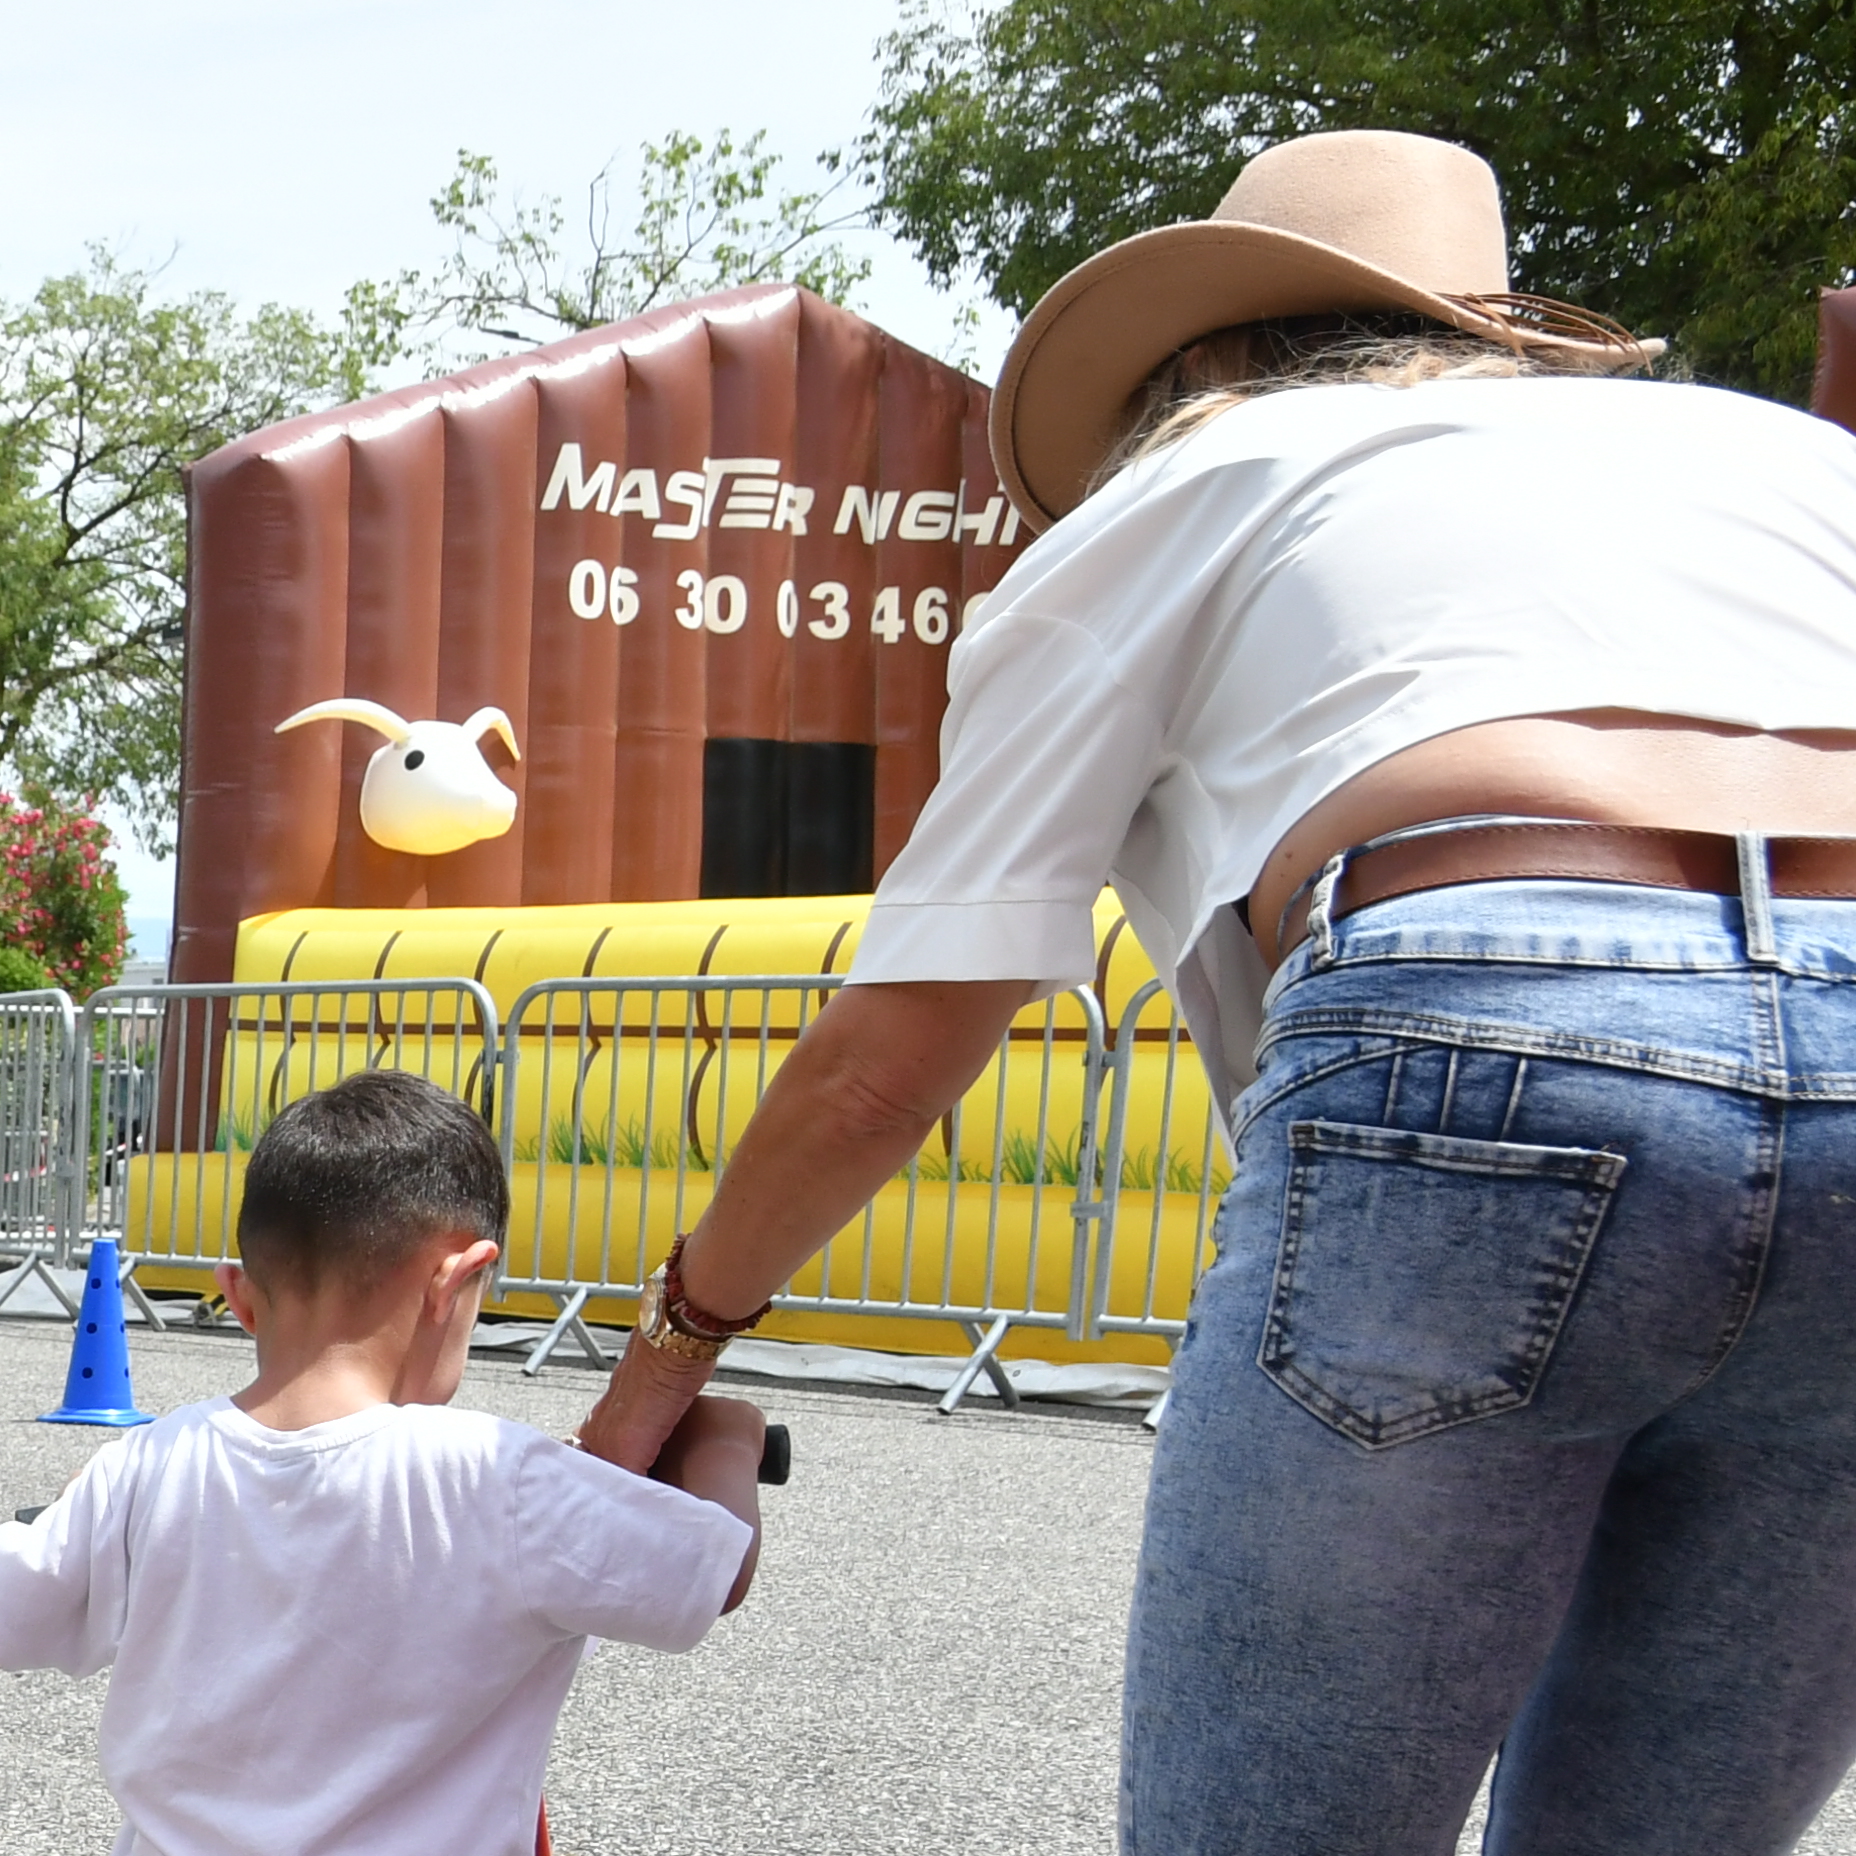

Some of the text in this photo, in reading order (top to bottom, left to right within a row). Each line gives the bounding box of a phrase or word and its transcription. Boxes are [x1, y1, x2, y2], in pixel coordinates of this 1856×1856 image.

[540, 442, 815, 541] MASTER
[569, 558, 640, 626] 06
[675, 569, 748, 634] 30
[776, 579, 851, 641] 03
[870, 586, 949, 645] 46
